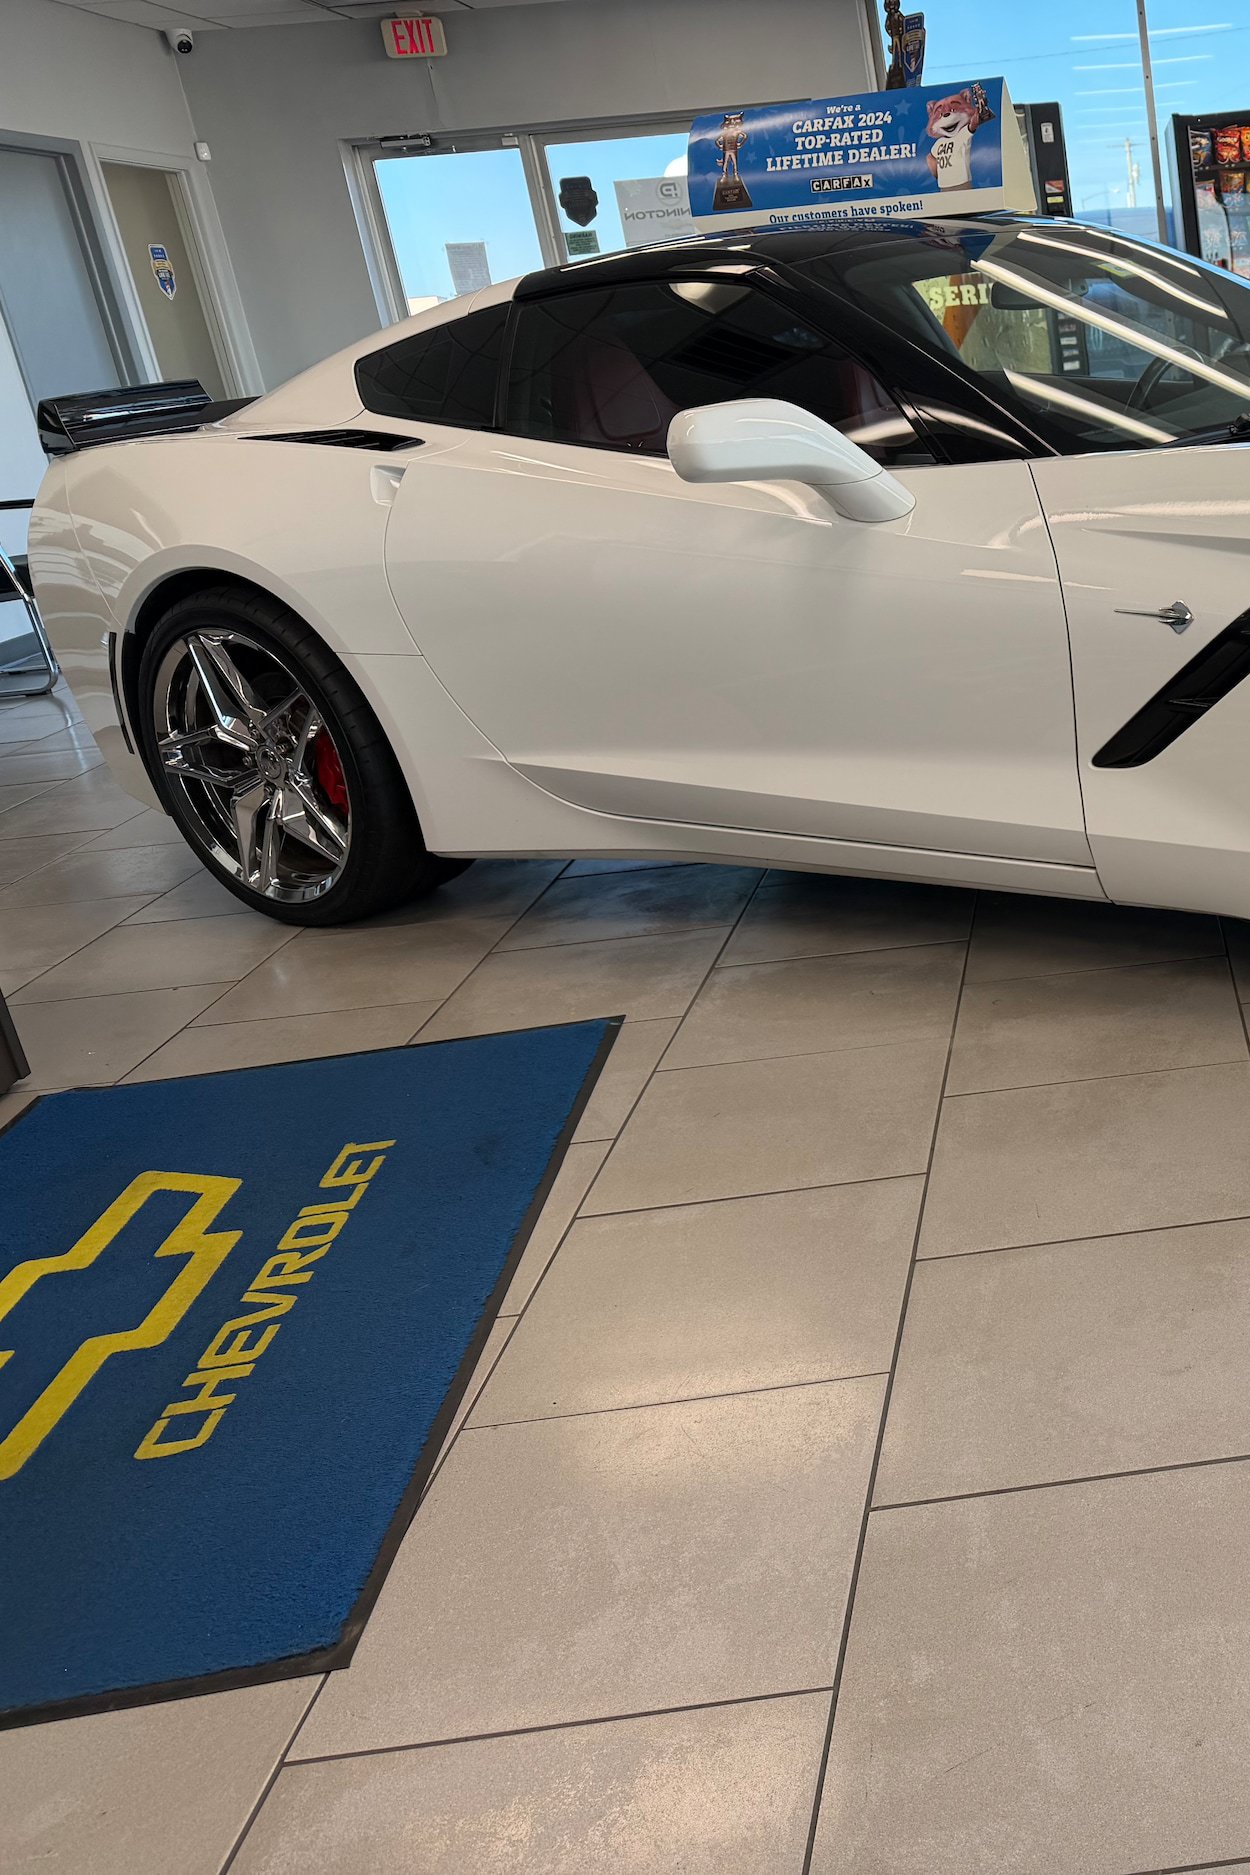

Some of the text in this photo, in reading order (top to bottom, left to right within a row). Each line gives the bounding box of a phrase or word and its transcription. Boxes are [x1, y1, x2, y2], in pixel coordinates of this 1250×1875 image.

[390, 18, 435, 55] EXIT
[826, 104, 853, 114] We're
[792, 111, 893, 134] CARFAX 2024
[795, 129, 884, 150] TOP-RATED
[937, 142, 954, 155] CAR
[766, 143, 917, 172] LIFETIME DEALER!
[812, 175, 872, 192] CARFAX
[769, 200, 923, 223] Our customers have spoken!
[134, 1139, 397, 1459] CHEVROLET
